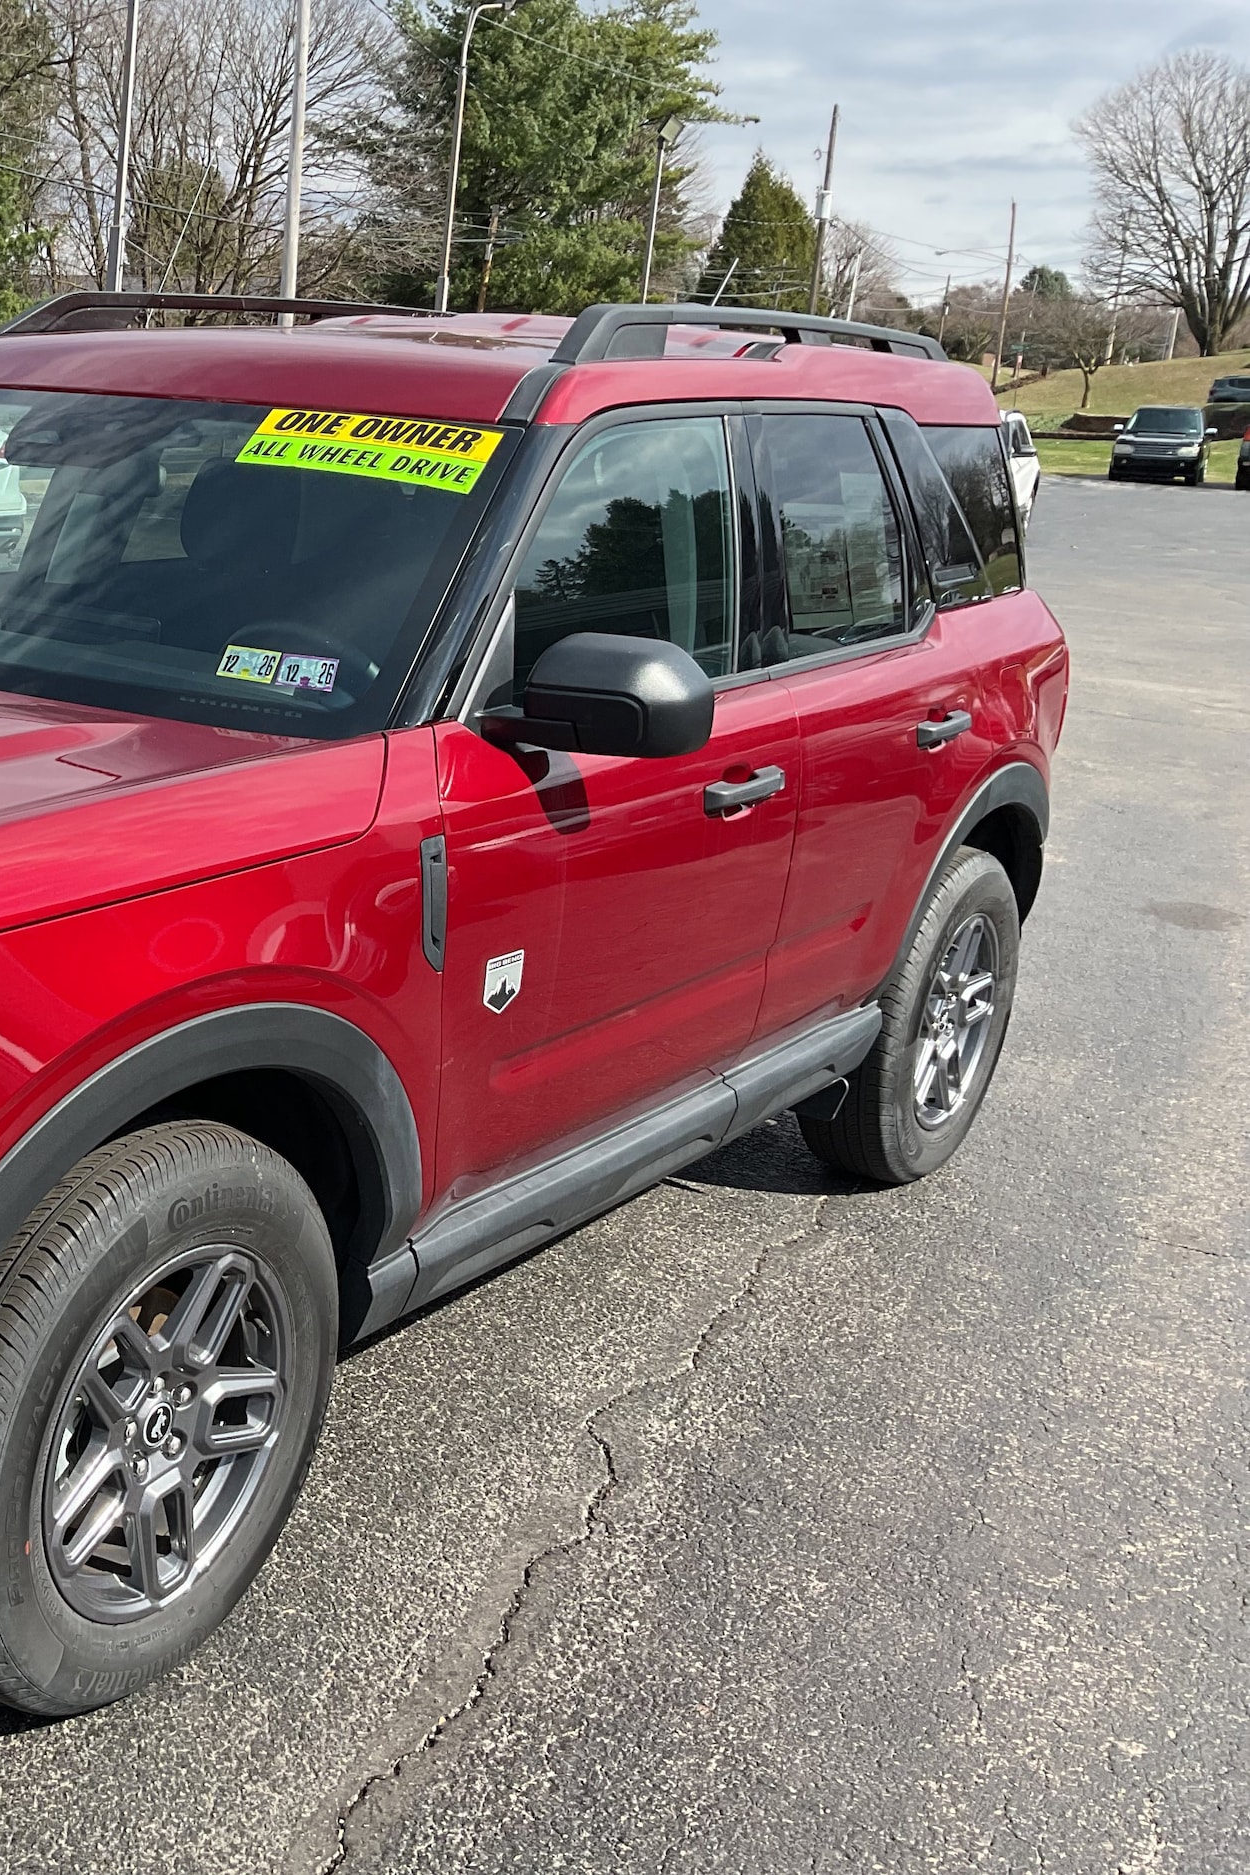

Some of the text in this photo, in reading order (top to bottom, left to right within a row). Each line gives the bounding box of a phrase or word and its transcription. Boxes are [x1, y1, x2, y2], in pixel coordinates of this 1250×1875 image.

[273, 411, 484, 454] ONE OWNER
[244, 439, 478, 484] ALL WHEEL DRIVE
[222, 654, 277, 677] 12 26
[286, 662, 335, 685] 12 26
